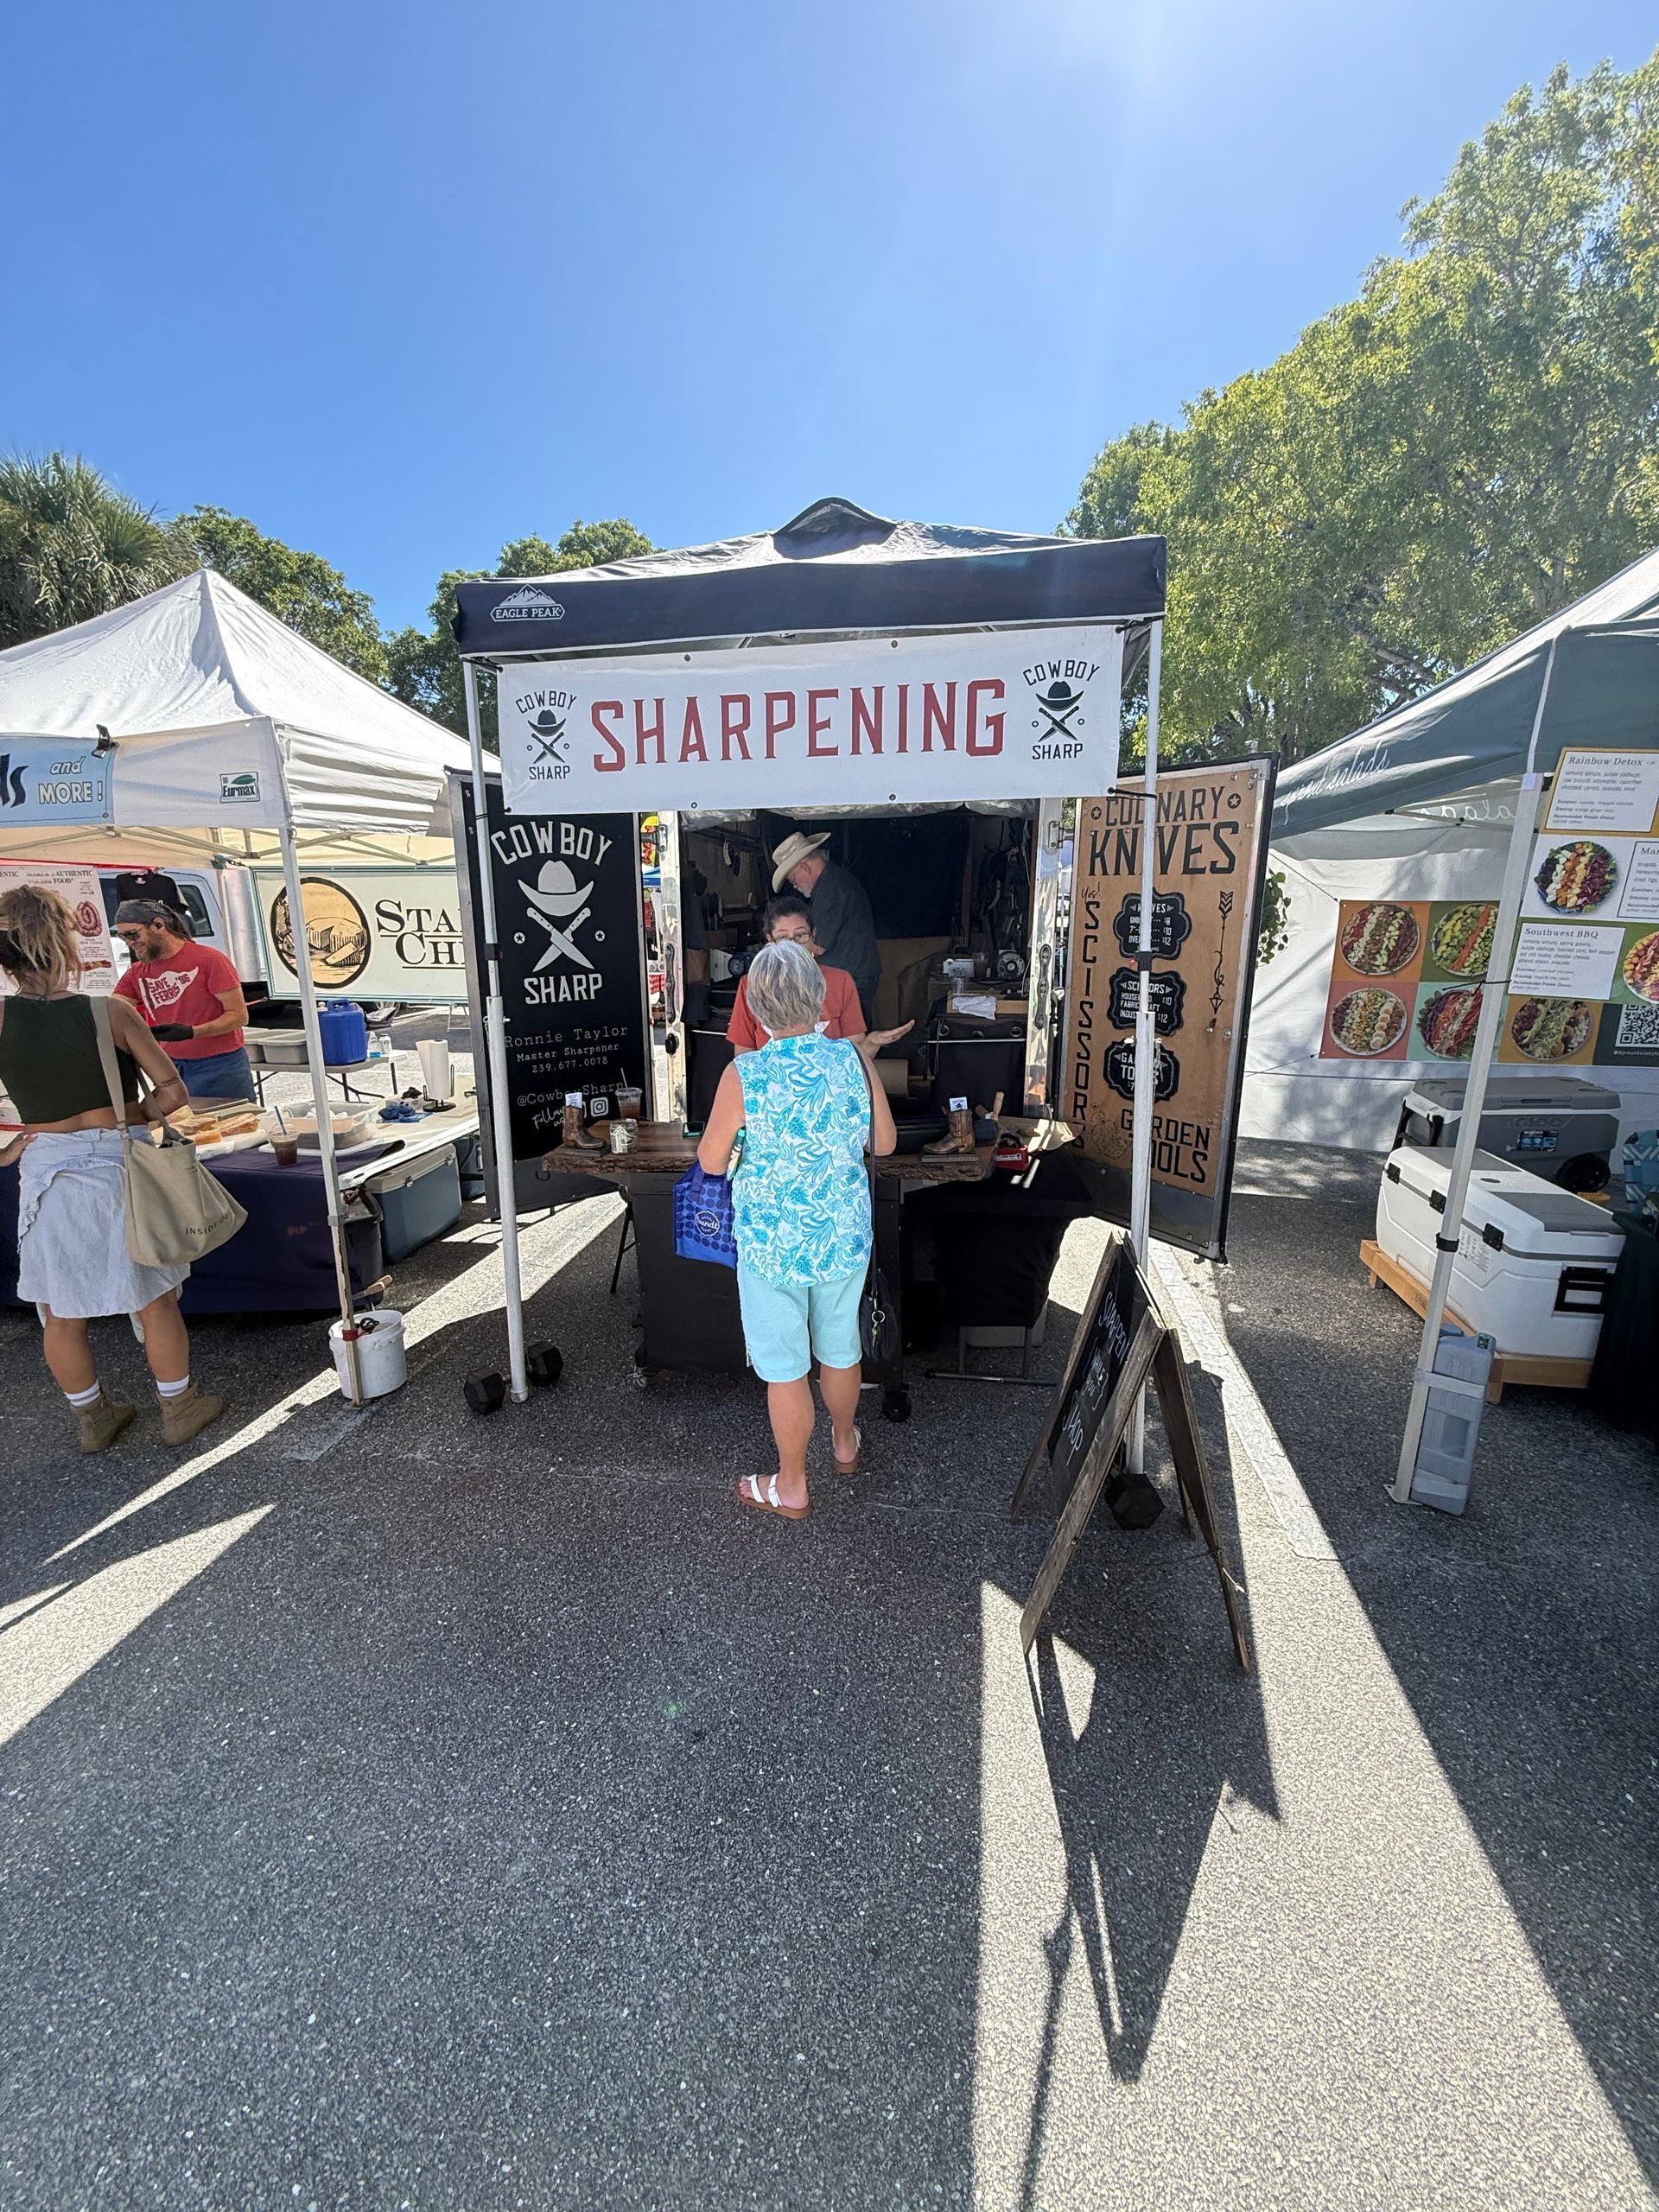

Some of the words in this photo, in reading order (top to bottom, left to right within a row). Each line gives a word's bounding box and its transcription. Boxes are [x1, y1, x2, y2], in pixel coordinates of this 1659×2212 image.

[496, 609, 528, 619] EAGLE
[531, 607, 560, 618] PEAK
[1023, 660, 1102, 686] COWBOY
[516, 690, 577, 714] COWBOY
[591, 679, 1007, 772] SHARPENING
[1033, 743, 1084, 760] SHARP
[1568, 756, 1612, 766] Rainbow
[1614, 758, 1644, 766] Detox
[50, 756, 87, 775] and
[530, 766, 570, 780] SHARP
[223, 785, 256, 798] Eurmax
[1106, 786, 1225, 827] CULNARY
[490, 821, 613, 866] COWBOY
[1089, 821, 1240, 876] KNVES
[375, 899, 462, 933] STA
[1525, 928, 1574, 938] Southwest
[1576, 931, 1599, 939] BBQ
[396, 932, 466, 965] CH
[149, 977, 171, 993] SAVE
[152, 982, 181, 1004] FERRIS
[523, 973, 603, 1005] SHARP
[1127, 981, 1165, 994] SCIORS
[505, 1030, 563, 1048] Ronnie
[573, 1026, 629, 1041] Taylor
[517, 1052, 558, 1063] Master
[564, 1043, 620, 1057] Sharpener
[532, 1056, 609, 1073] 239.677.0078
[517, 1082, 625, 1107] @CowbSharp
[1121, 1108, 1211, 1151] GRDEN
[696, 1216, 719, 1230] bundt
[1098, 1291, 1130, 1365] SHARPEN
[1063, 1389, 1084, 1467] SHOP
